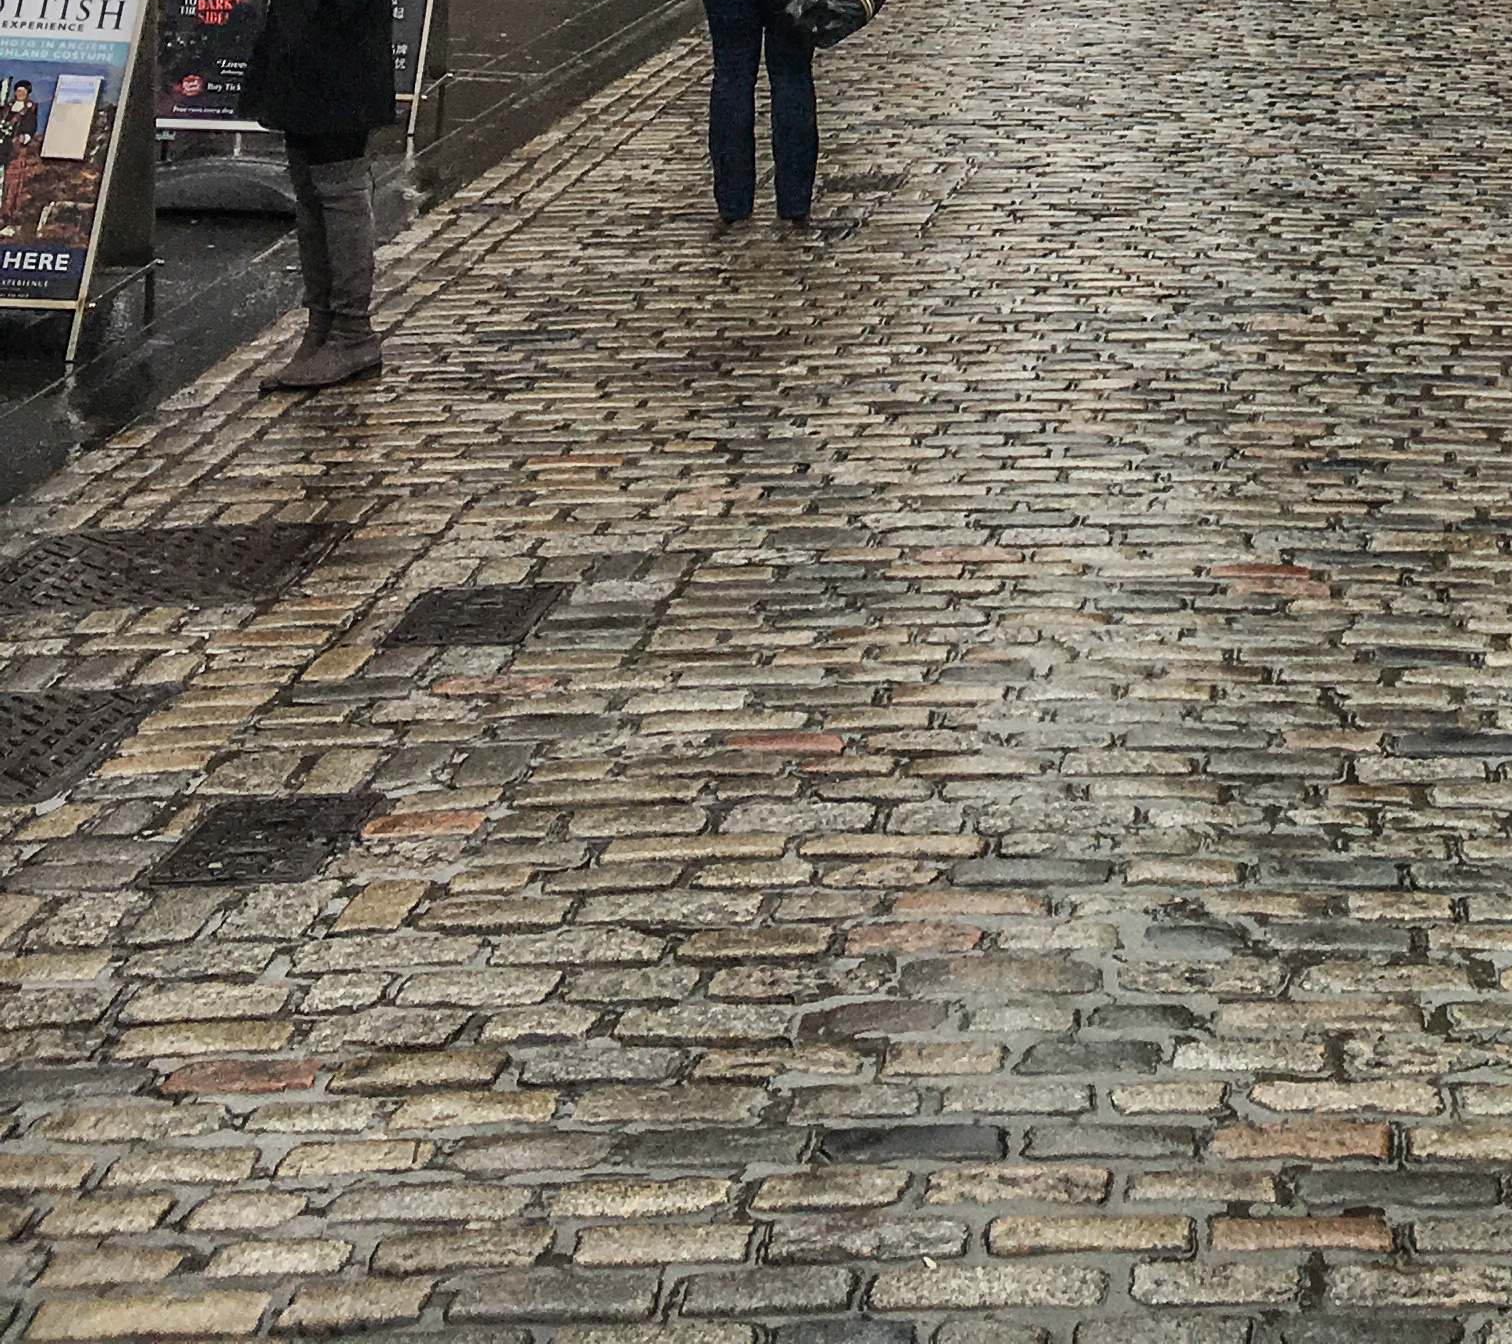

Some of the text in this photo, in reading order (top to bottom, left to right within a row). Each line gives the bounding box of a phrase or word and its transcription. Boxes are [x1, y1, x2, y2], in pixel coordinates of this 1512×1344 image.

[180, 6, 197, 16] THE
[2, 20, 84, 32] EXPERIENCE
[41, 40, 55, 49] IN
[58, 41, 115, 51] ANCIENT
[53, 49, 114, 62] COSTUME
[2, 251, 70, 271] HERE
